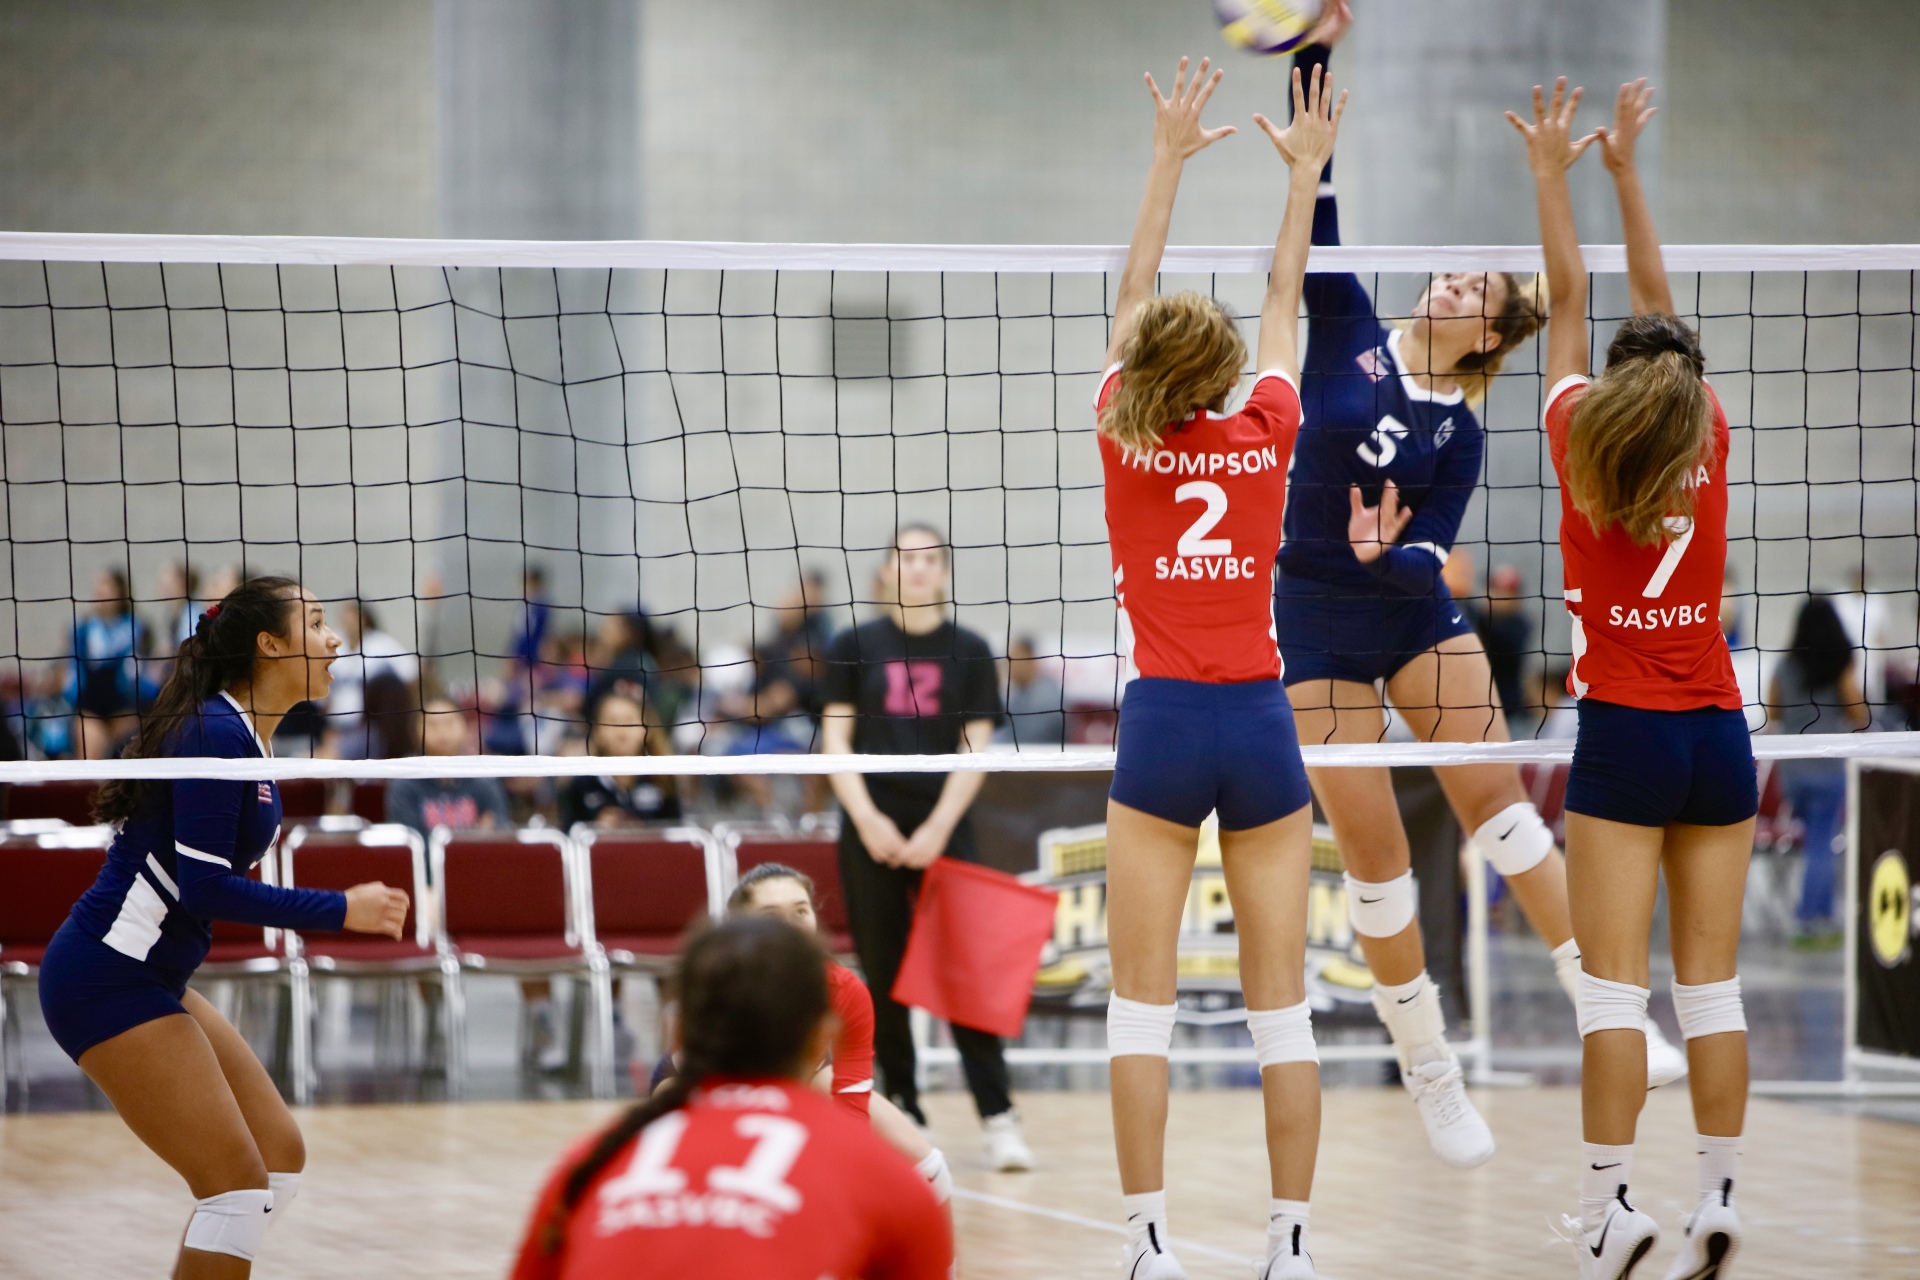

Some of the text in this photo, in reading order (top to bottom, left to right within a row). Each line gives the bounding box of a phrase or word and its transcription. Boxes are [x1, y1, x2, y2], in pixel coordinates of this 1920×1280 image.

[1120, 443, 1278, 476] THOMPSON
[1356, 414, 1410, 468] 5
[1175, 480, 1232, 557] 2
[1155, 556, 1255, 580] SASVBC
[1643, 516, 1695, 598] 7
[1608, 602, 1708, 630] SASVBC
